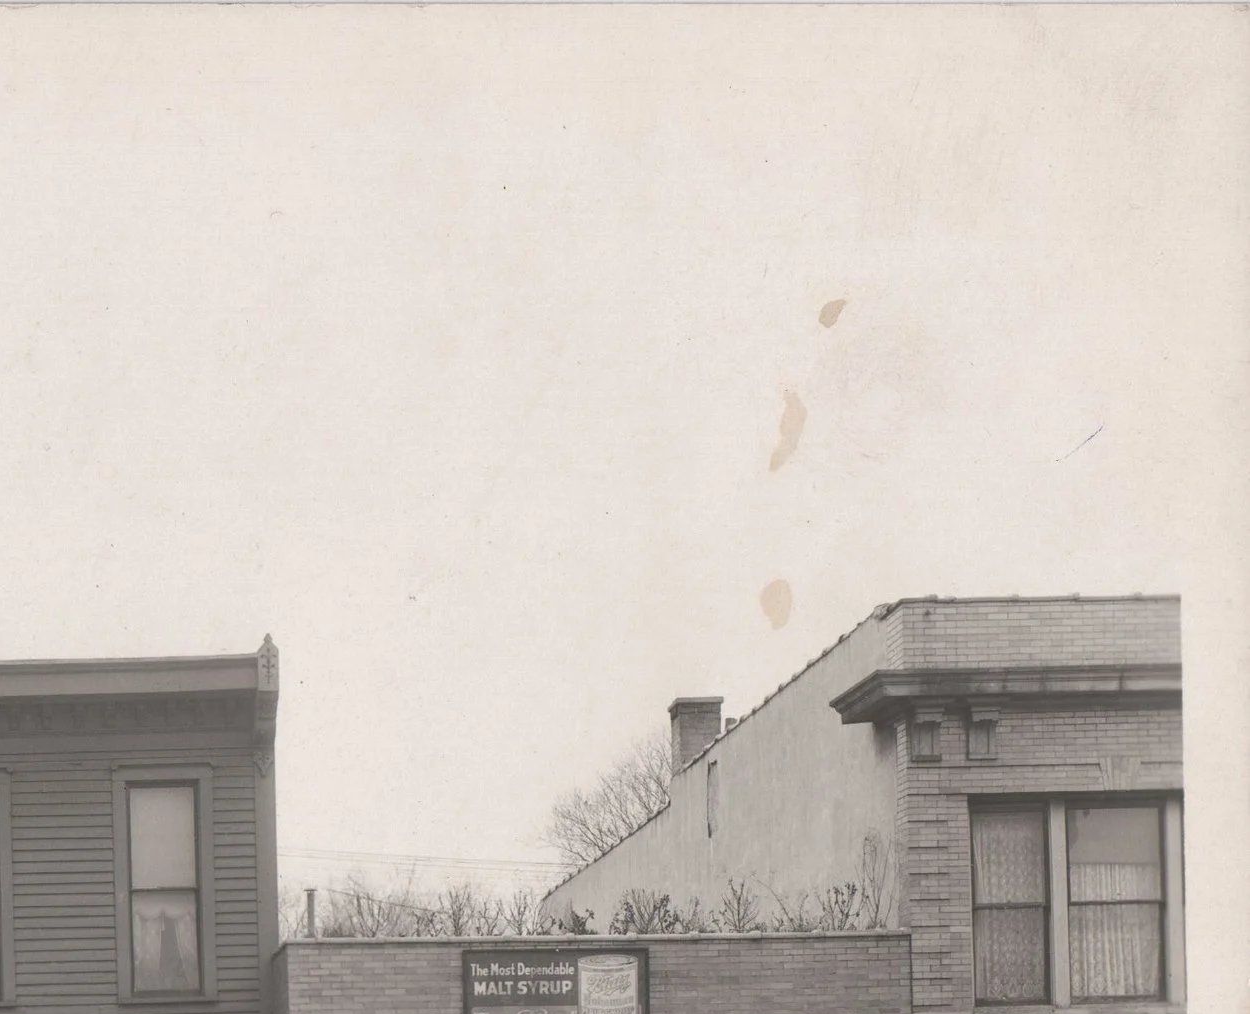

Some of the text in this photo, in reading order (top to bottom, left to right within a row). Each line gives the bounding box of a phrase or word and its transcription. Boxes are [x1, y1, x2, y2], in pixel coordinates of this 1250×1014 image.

[470, 961, 575, 978] The Most Dependable
[473, 980, 573, 996] MALT SYRUP
